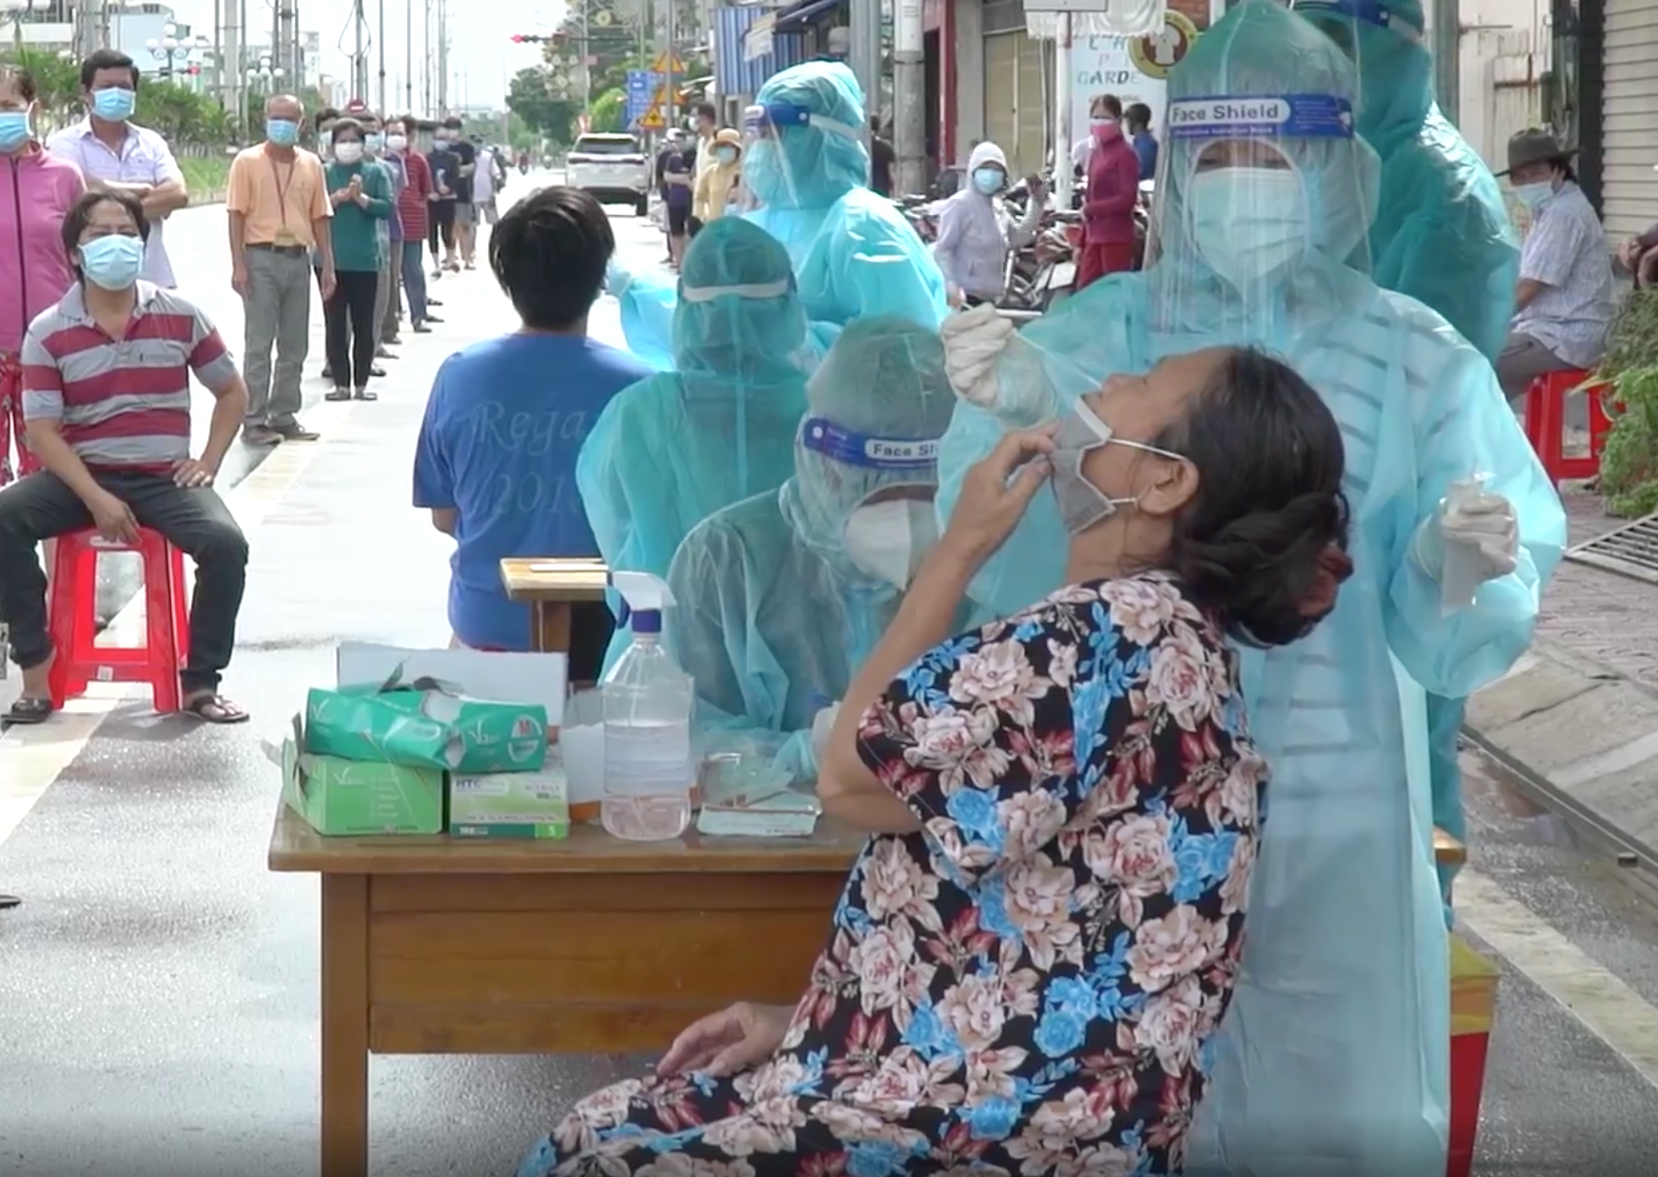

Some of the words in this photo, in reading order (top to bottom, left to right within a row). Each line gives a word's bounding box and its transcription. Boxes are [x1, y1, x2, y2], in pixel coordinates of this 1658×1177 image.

[1172, 107, 1206, 122] Face
[1213, 103, 1279, 120] Shield
[873, 443, 912, 456] Face
[491, 471, 580, 514] 201
